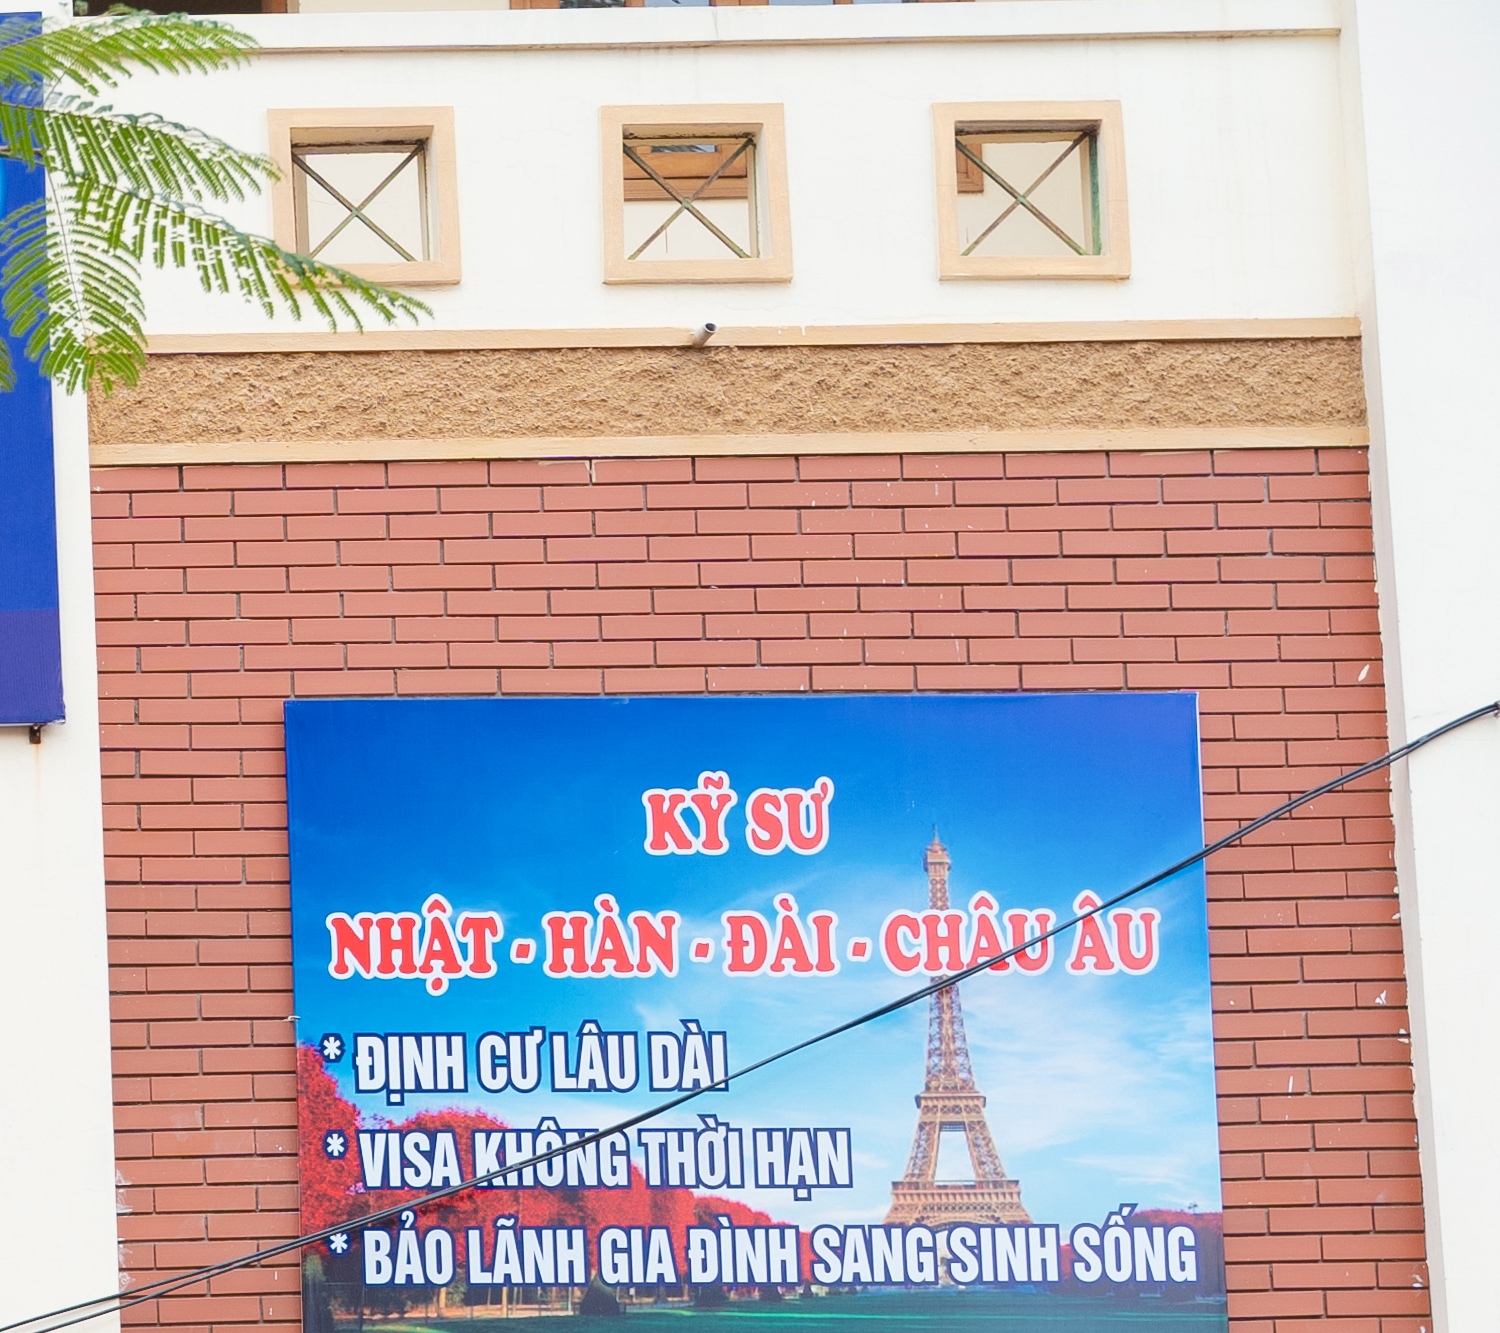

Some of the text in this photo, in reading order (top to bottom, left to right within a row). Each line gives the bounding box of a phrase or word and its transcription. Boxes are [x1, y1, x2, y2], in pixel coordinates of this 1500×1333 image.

[642, 771, 834, 855] KỸ SƯ
[326, 889, 1162, 996] NHẬT HÀN ĐÀI CHÂU ÂU
[354, 1019, 729, 1106] ĐỊNH CƯ LÂU DÀI
[357, 1114, 853, 1201] VISA KHÔNG THỜI HẠN
[362, 1204, 1198, 1286] BẢO LÃNH GIA ĐÌNH SANG SINH SỐNG
